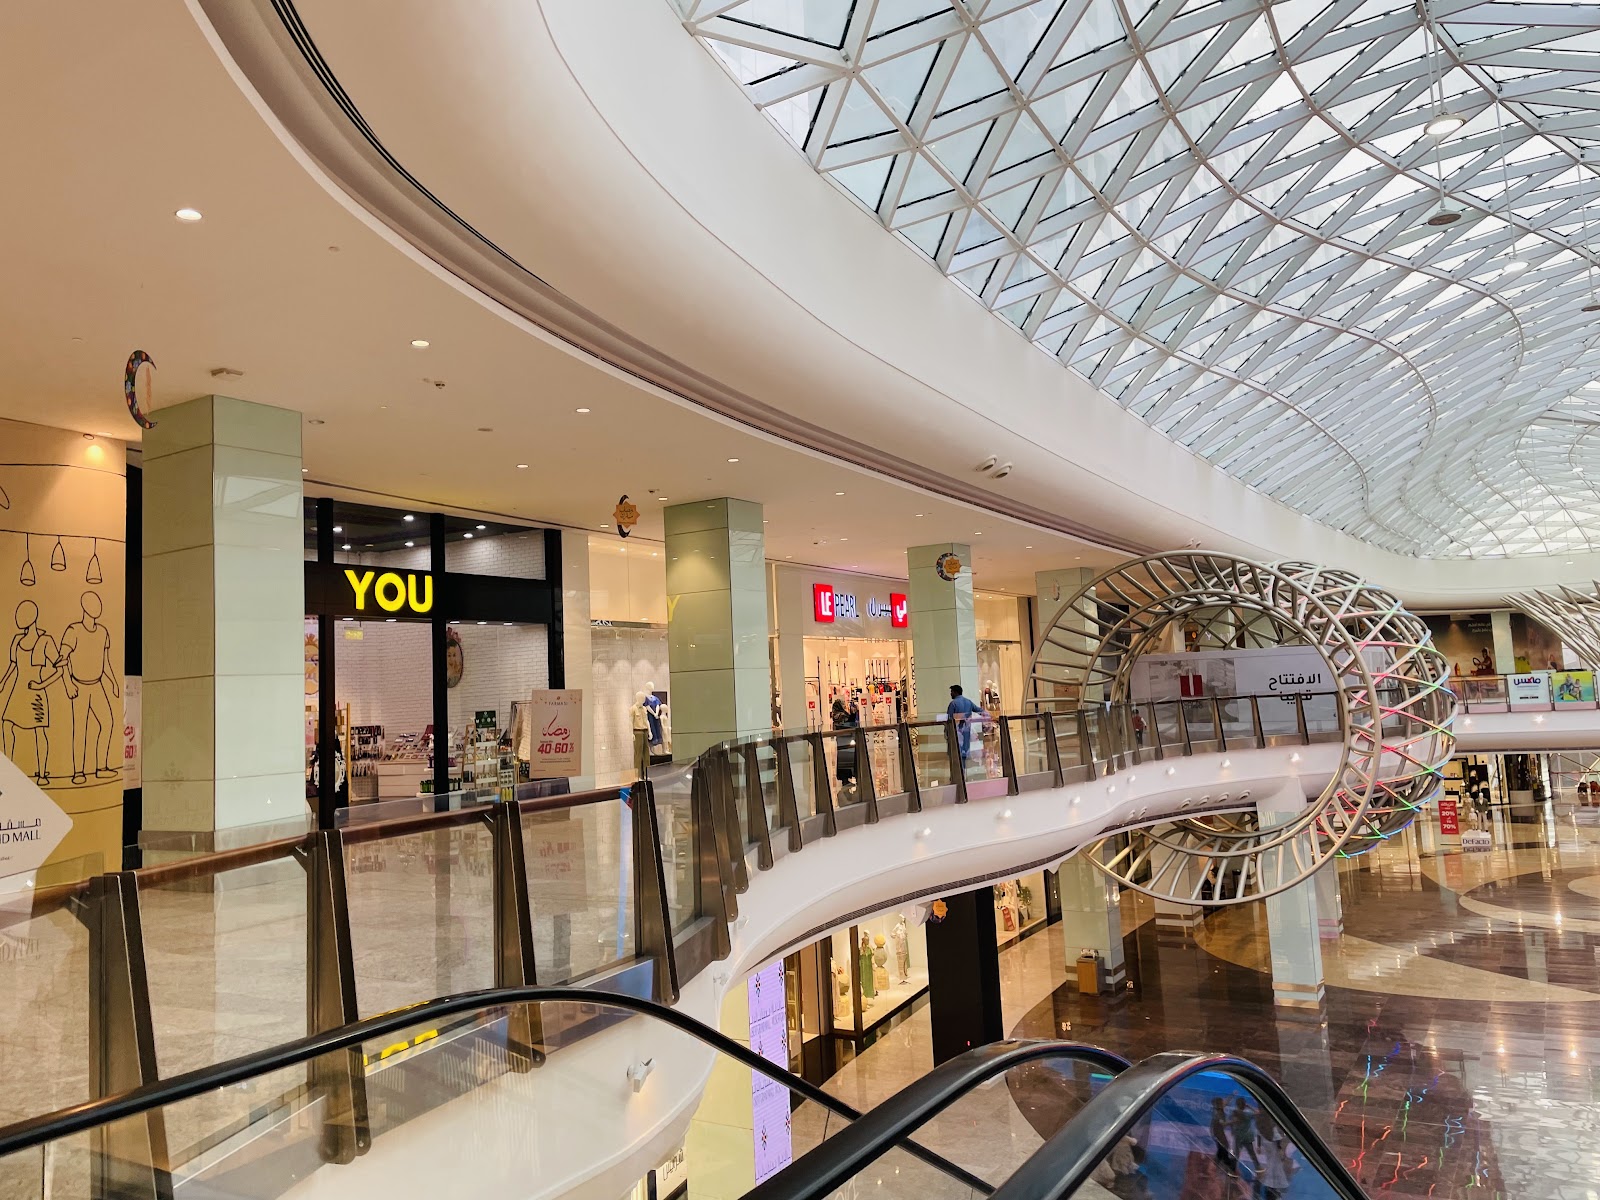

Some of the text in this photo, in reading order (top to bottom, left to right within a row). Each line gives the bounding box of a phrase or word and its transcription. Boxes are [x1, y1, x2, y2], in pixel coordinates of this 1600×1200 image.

[344, 569, 433, 612] YOU
[821, 591, 859, 617] LE PEARL
[1269, 673, 1321, 691] الافتتاح
[13, 830, 41, 843] MALL
